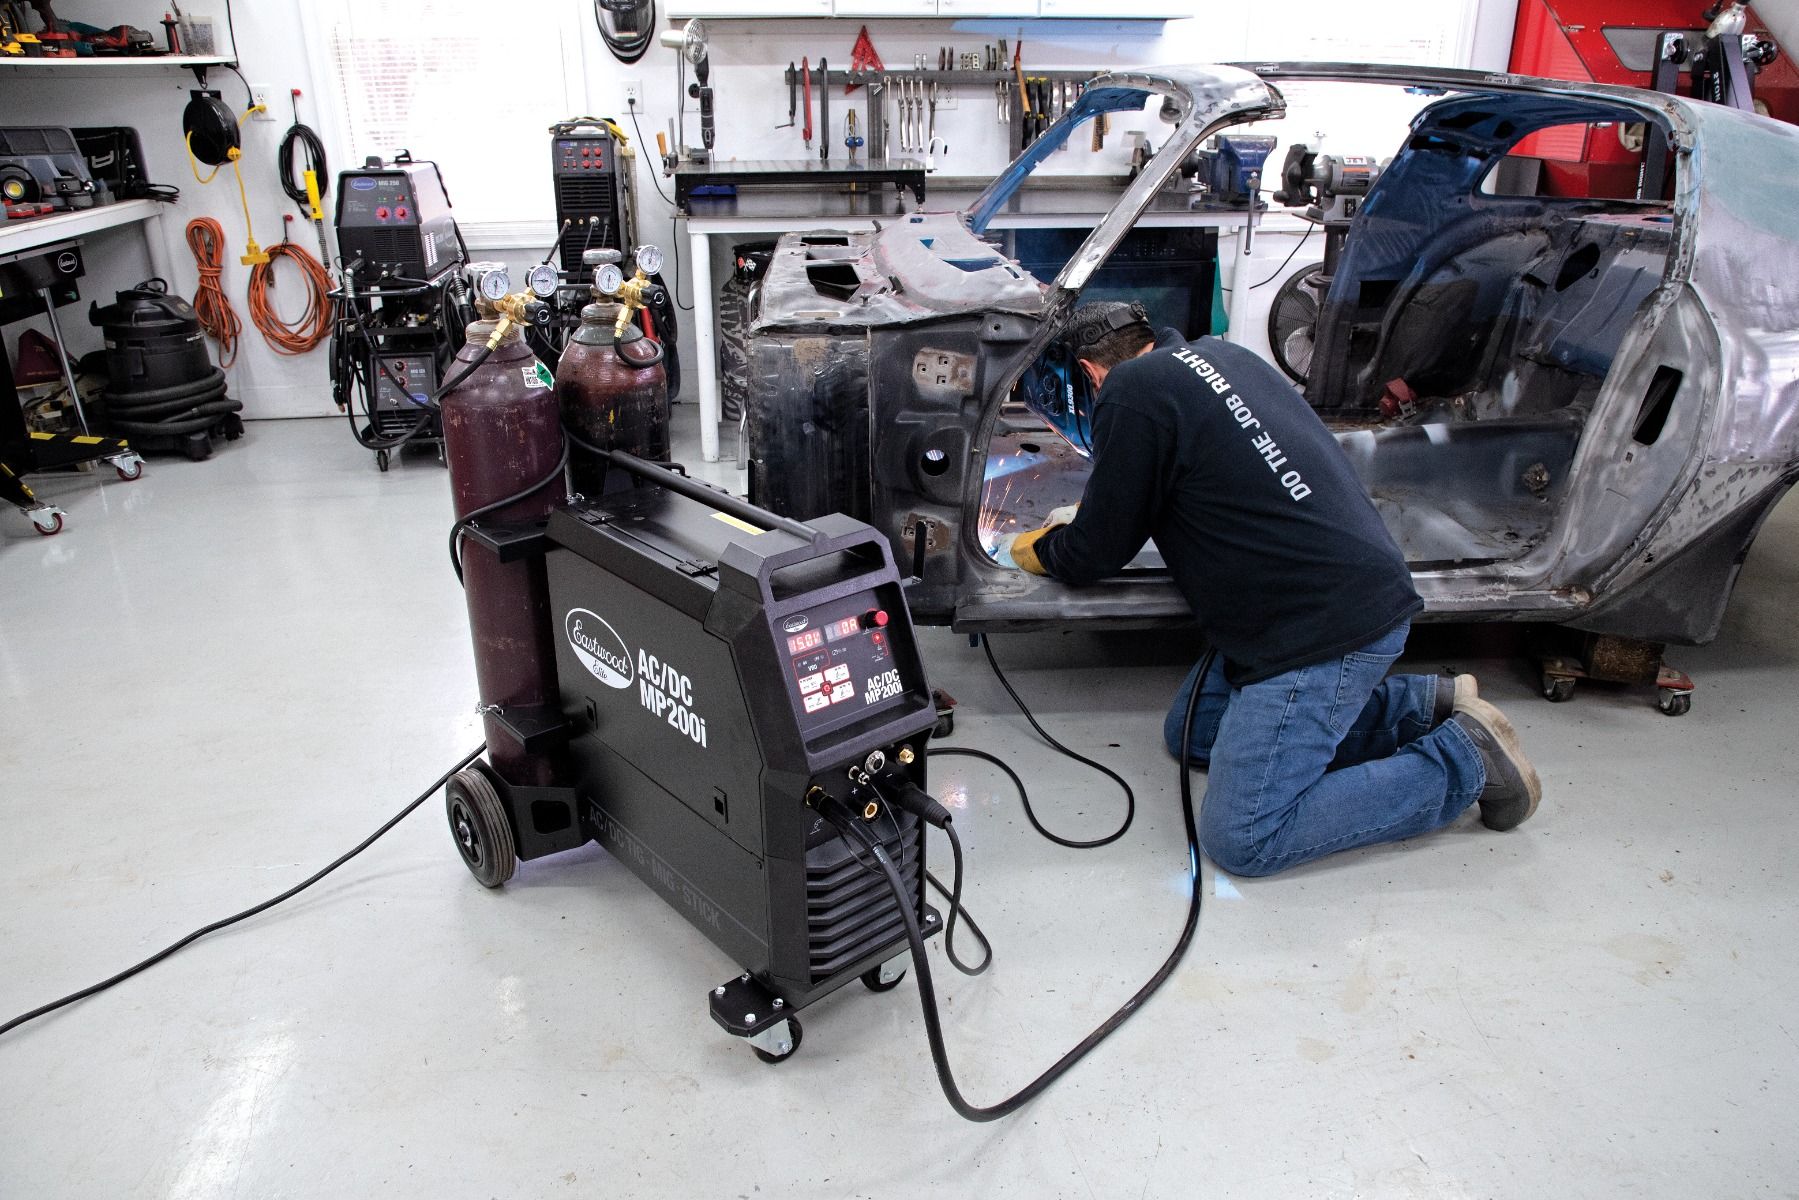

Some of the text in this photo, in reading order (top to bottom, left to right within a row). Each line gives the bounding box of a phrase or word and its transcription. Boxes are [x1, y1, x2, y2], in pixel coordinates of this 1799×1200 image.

[1172, 347, 1312, 501] DO THE JOB RIGHT.
[572, 619, 627, 674] Eastwood
[592, 659, 608, 681] Elite
[638, 648, 693, 707] AC/DC
[864, 680, 903, 704] MP200i
[867, 668, 900, 691] AC/DC
[639, 678, 707, 749] MP200i
[683, 885, 721, 930] STICK
